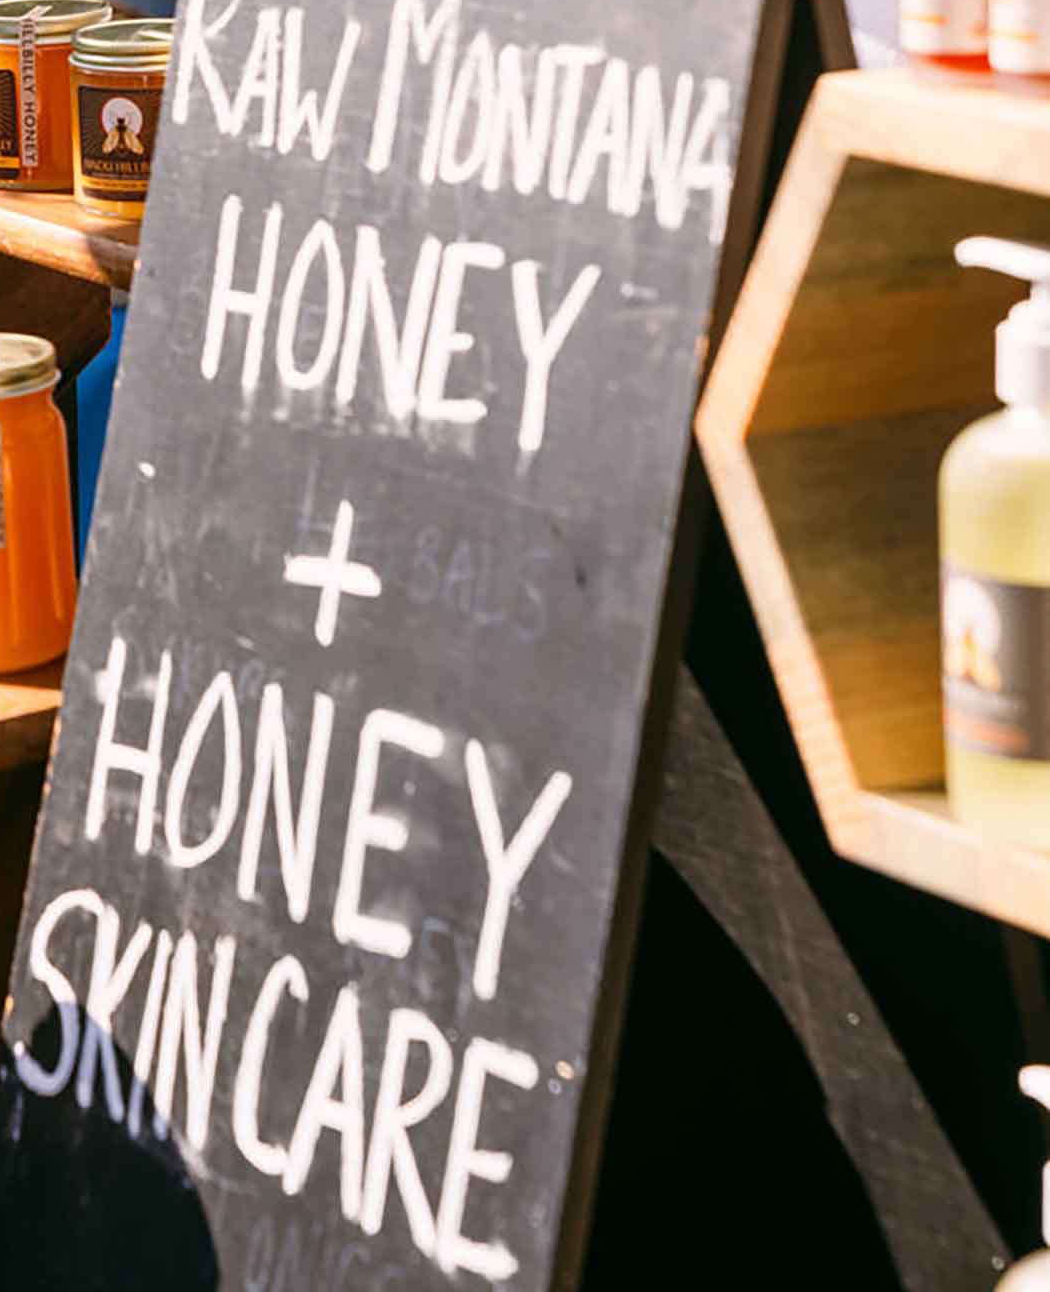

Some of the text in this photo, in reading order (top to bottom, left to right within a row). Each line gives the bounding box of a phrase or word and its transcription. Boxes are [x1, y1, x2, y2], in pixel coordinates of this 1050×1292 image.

[24, 102, 37, 162] HONEY
[200, 194, 602, 452] HONEY
[84, 635, 574, 1001] HONEY
[14, 888, 540, 1281] SKINCARE
